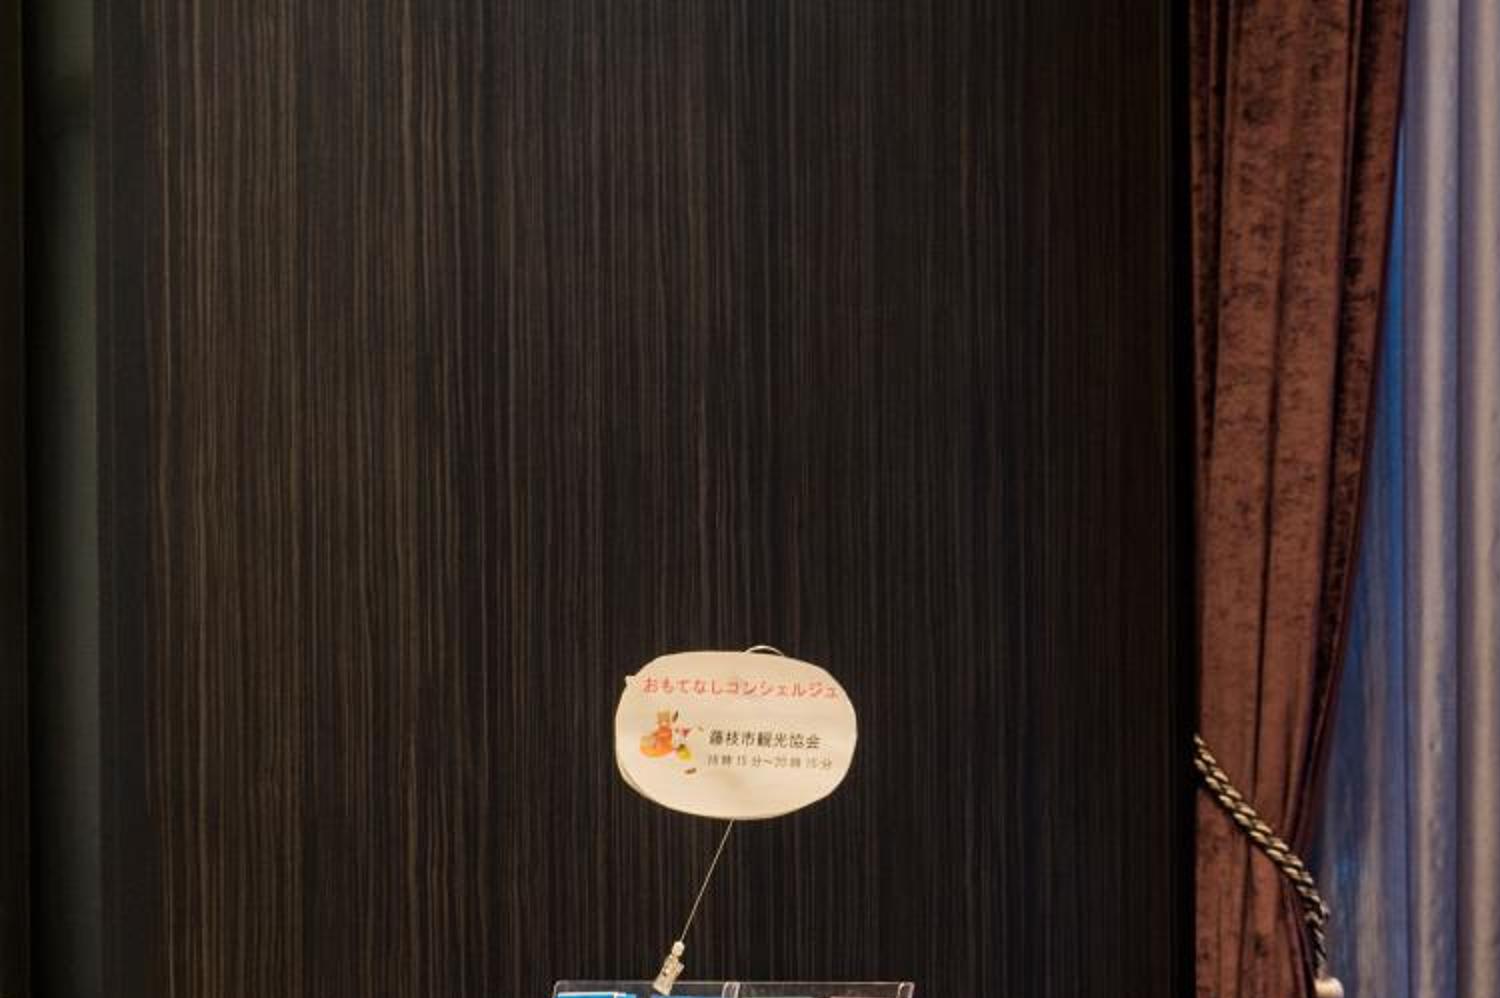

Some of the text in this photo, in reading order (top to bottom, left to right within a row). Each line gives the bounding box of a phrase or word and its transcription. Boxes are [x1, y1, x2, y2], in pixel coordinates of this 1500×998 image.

[642, 676, 838, 699] おもてなしコンシェルジュ
